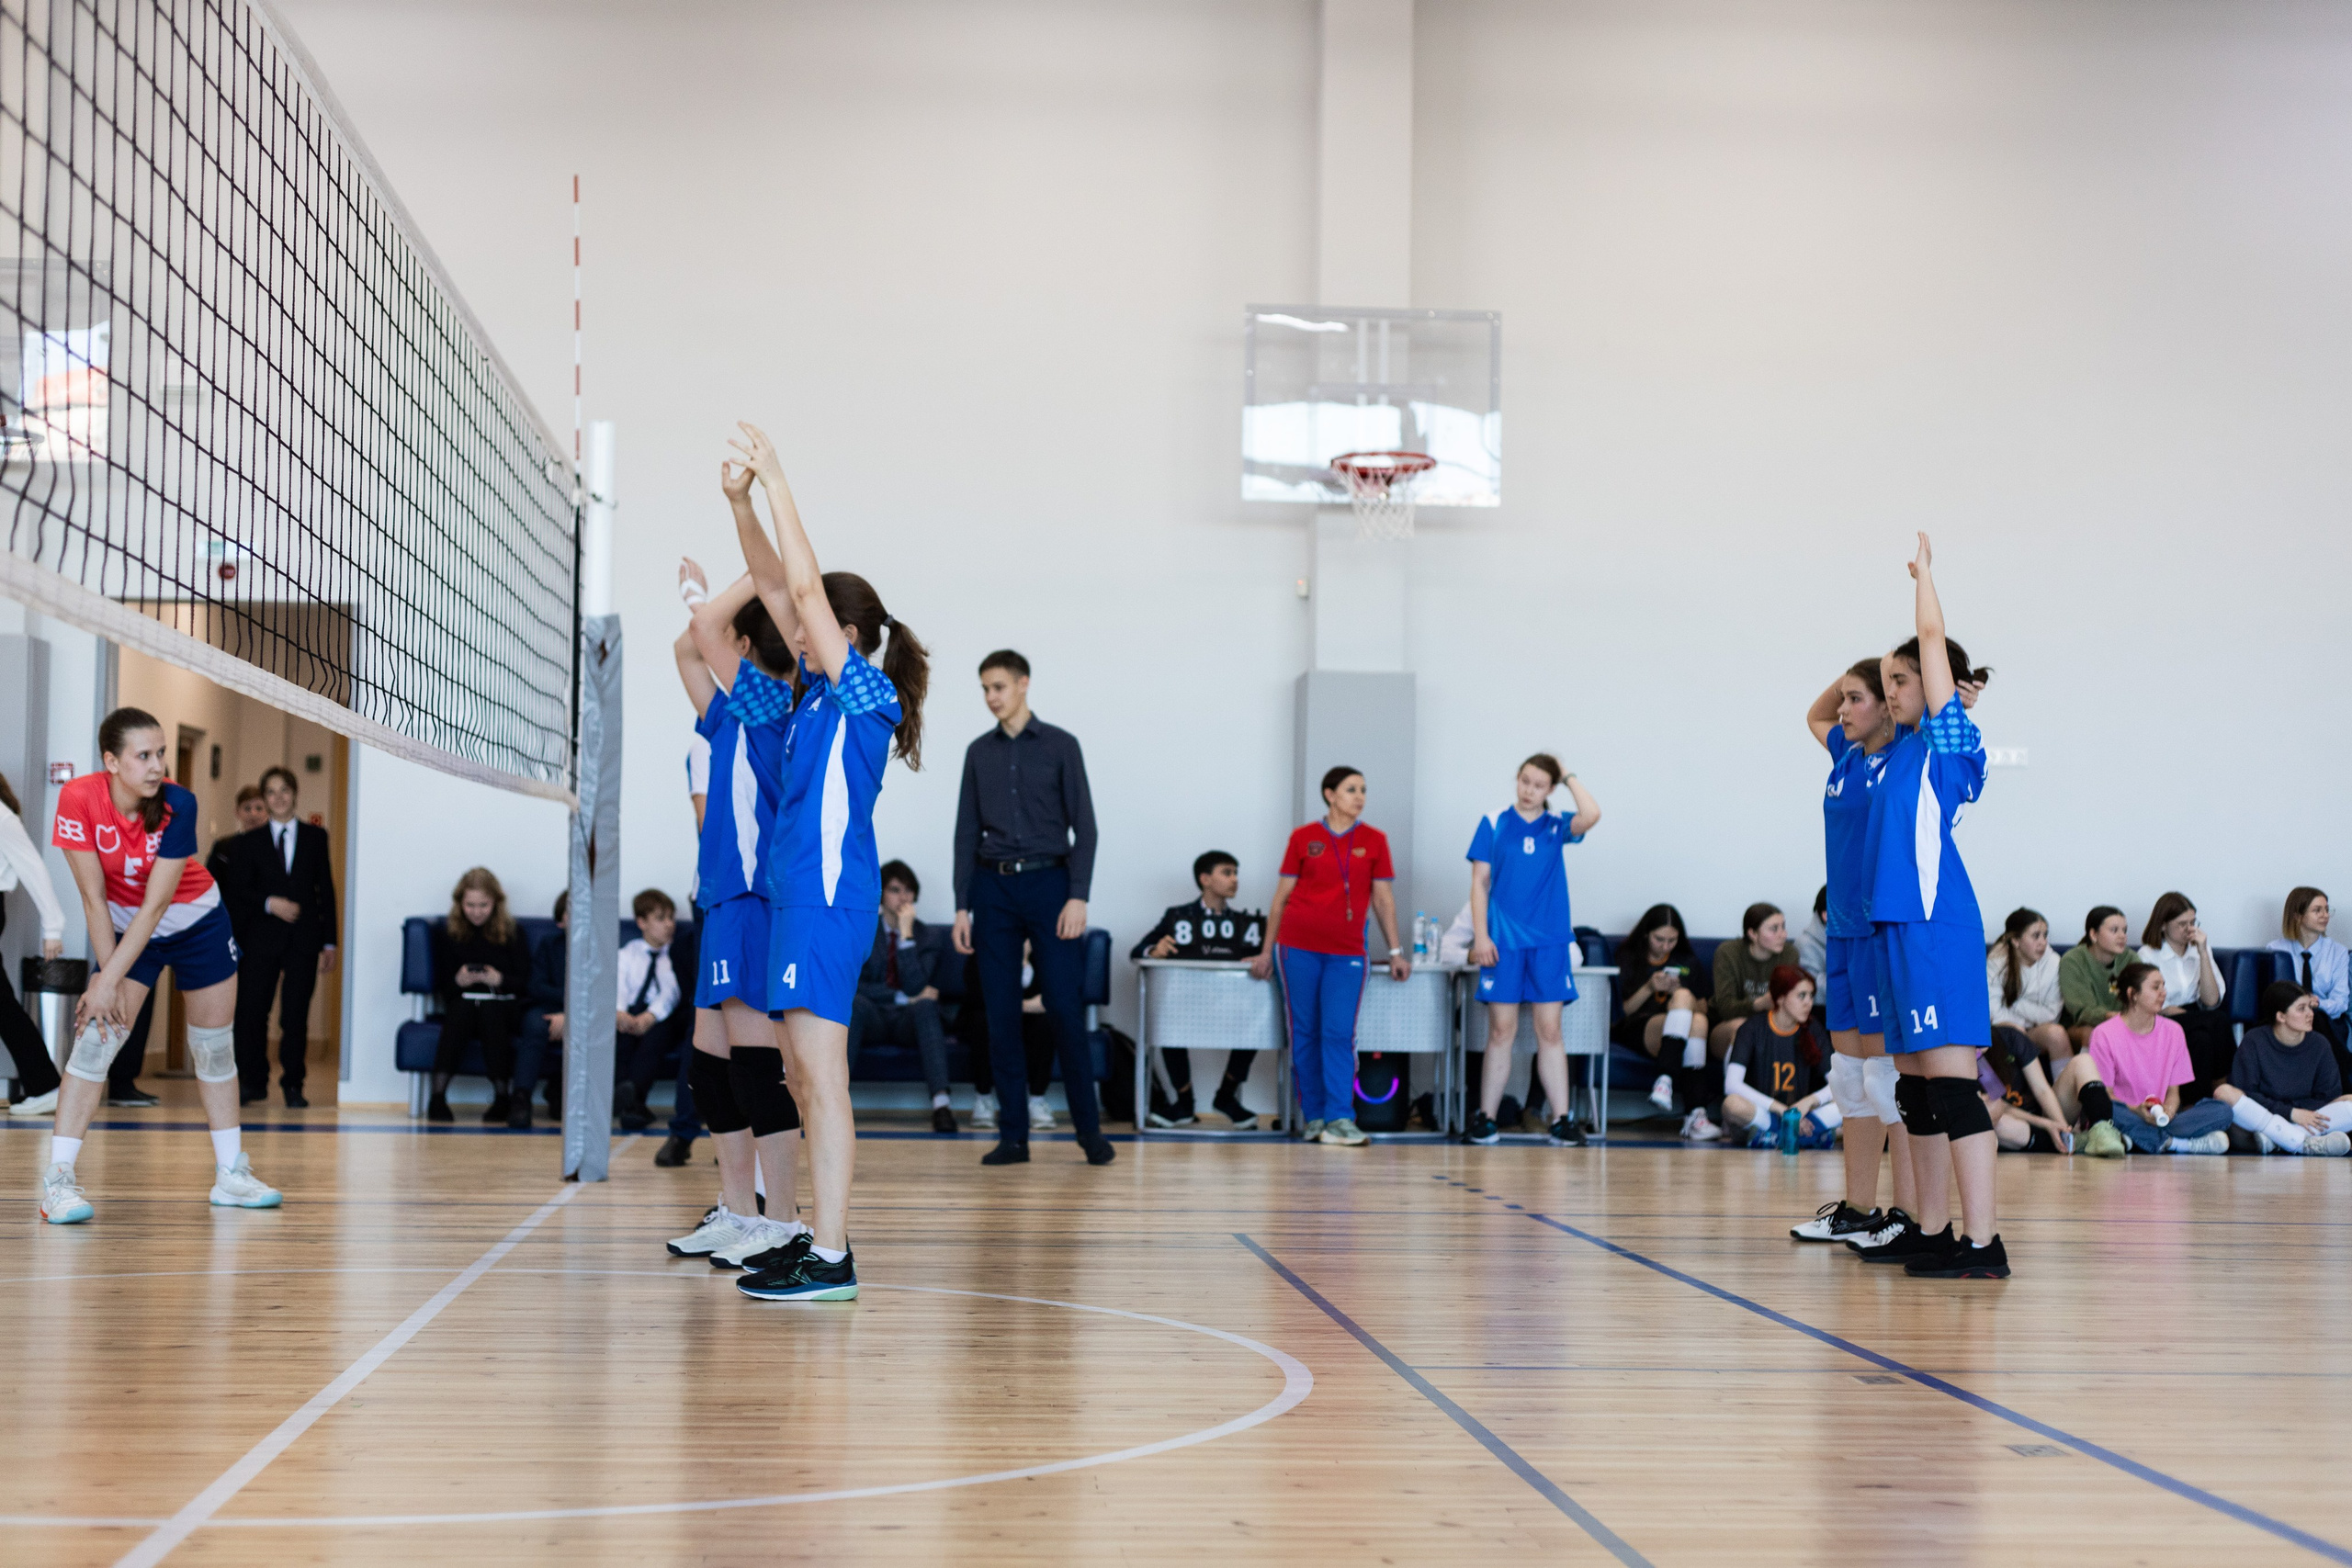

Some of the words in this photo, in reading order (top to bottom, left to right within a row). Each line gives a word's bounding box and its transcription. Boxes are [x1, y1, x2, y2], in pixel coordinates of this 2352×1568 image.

[1523, 836, 1535, 855] 8
[712, 959, 730, 986] 11
[782, 963, 797, 989] 4
[1910, 1005, 1939, 1034] 14
[1772, 1061, 1796, 1091] 12
